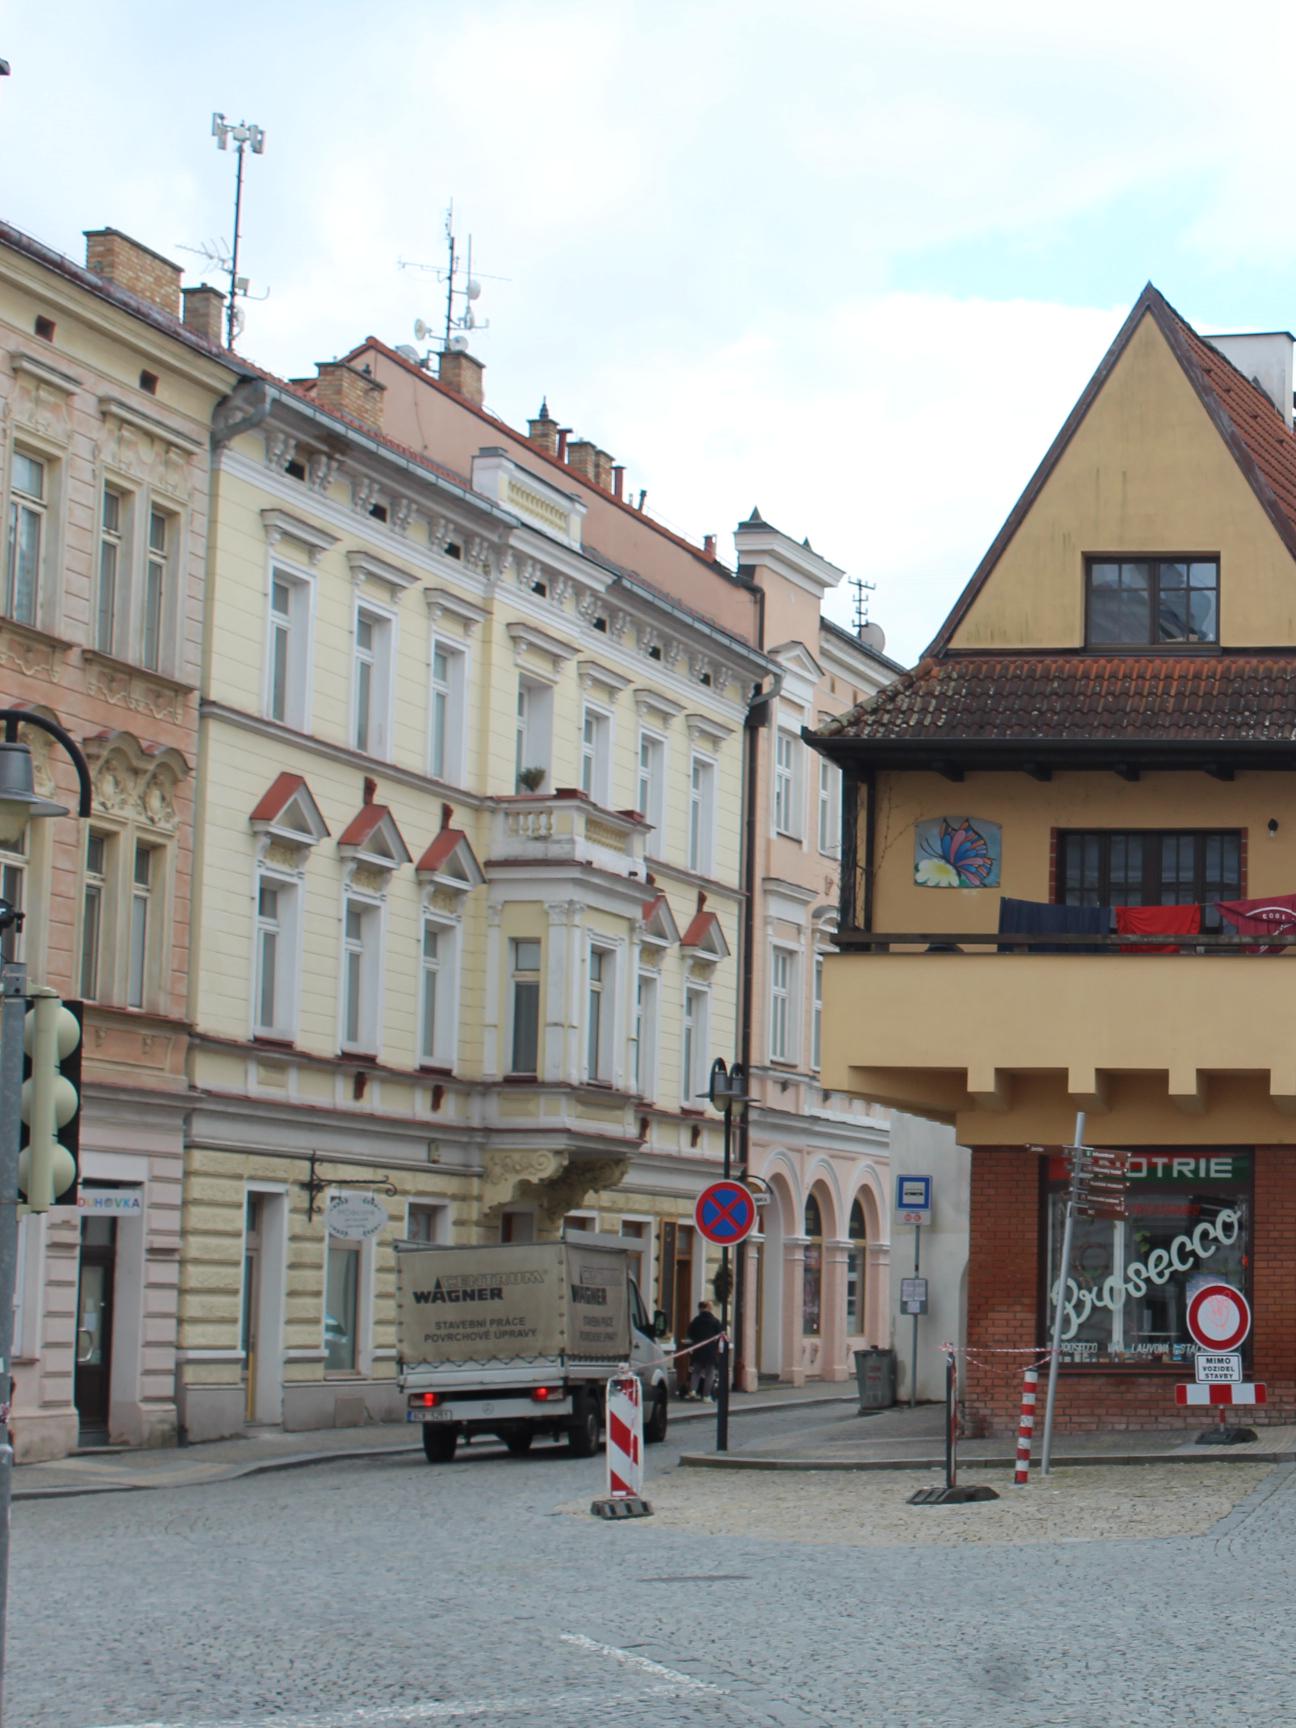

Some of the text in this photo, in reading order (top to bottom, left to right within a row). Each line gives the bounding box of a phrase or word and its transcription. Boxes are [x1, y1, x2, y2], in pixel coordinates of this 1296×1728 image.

[1051, 1209, 1241, 1340] Prosecco
[413, 1277, 504, 1304] WAGNER
[435, 1316, 526, 1330] STAVEBNÍ PRÁCE
[424, 1330, 490, 1343] POVRCHOVÉ
